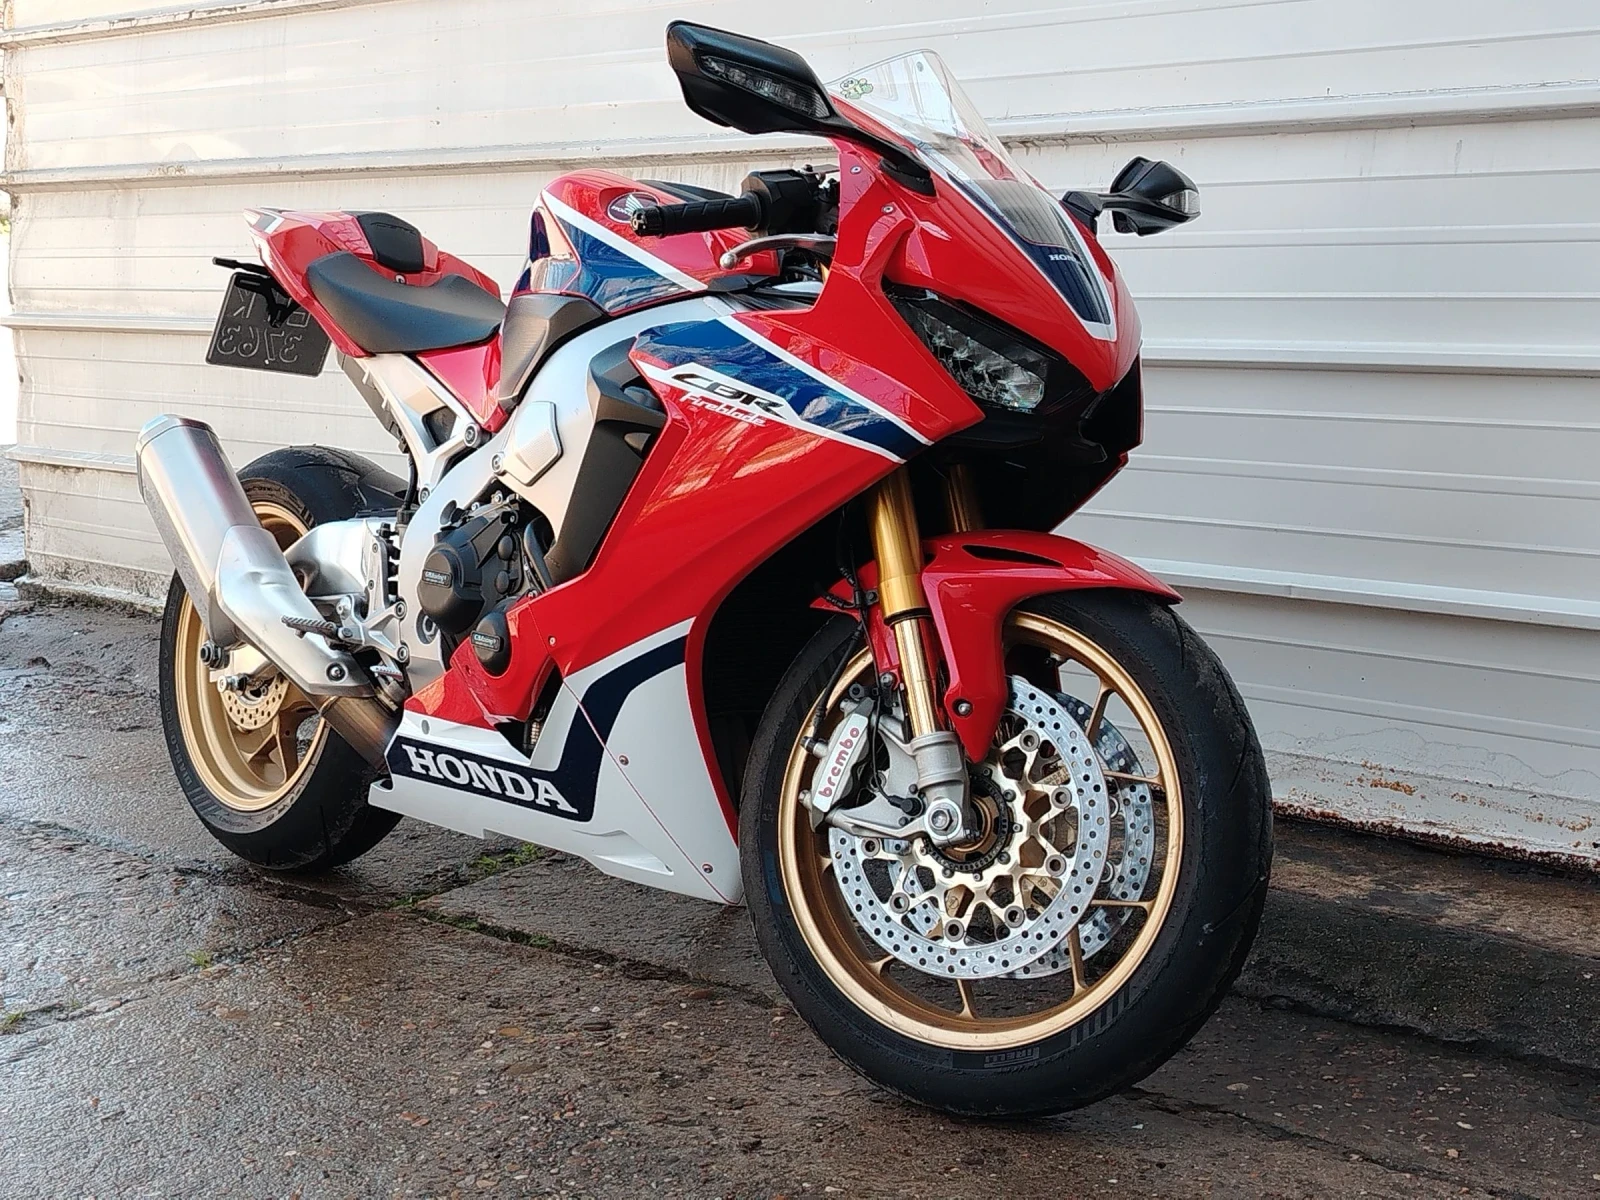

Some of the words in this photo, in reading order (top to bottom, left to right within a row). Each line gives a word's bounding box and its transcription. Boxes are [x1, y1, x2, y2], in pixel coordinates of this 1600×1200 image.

[671, 373, 788, 421] CBR
[679, 391, 766, 427] Fireblade
[169, 734, 193, 787] DIABLO
[401, 744, 579, 814] HONDA
[818, 727, 860, 798] brembo
[984, 1047, 1040, 1068] PIRELLI
